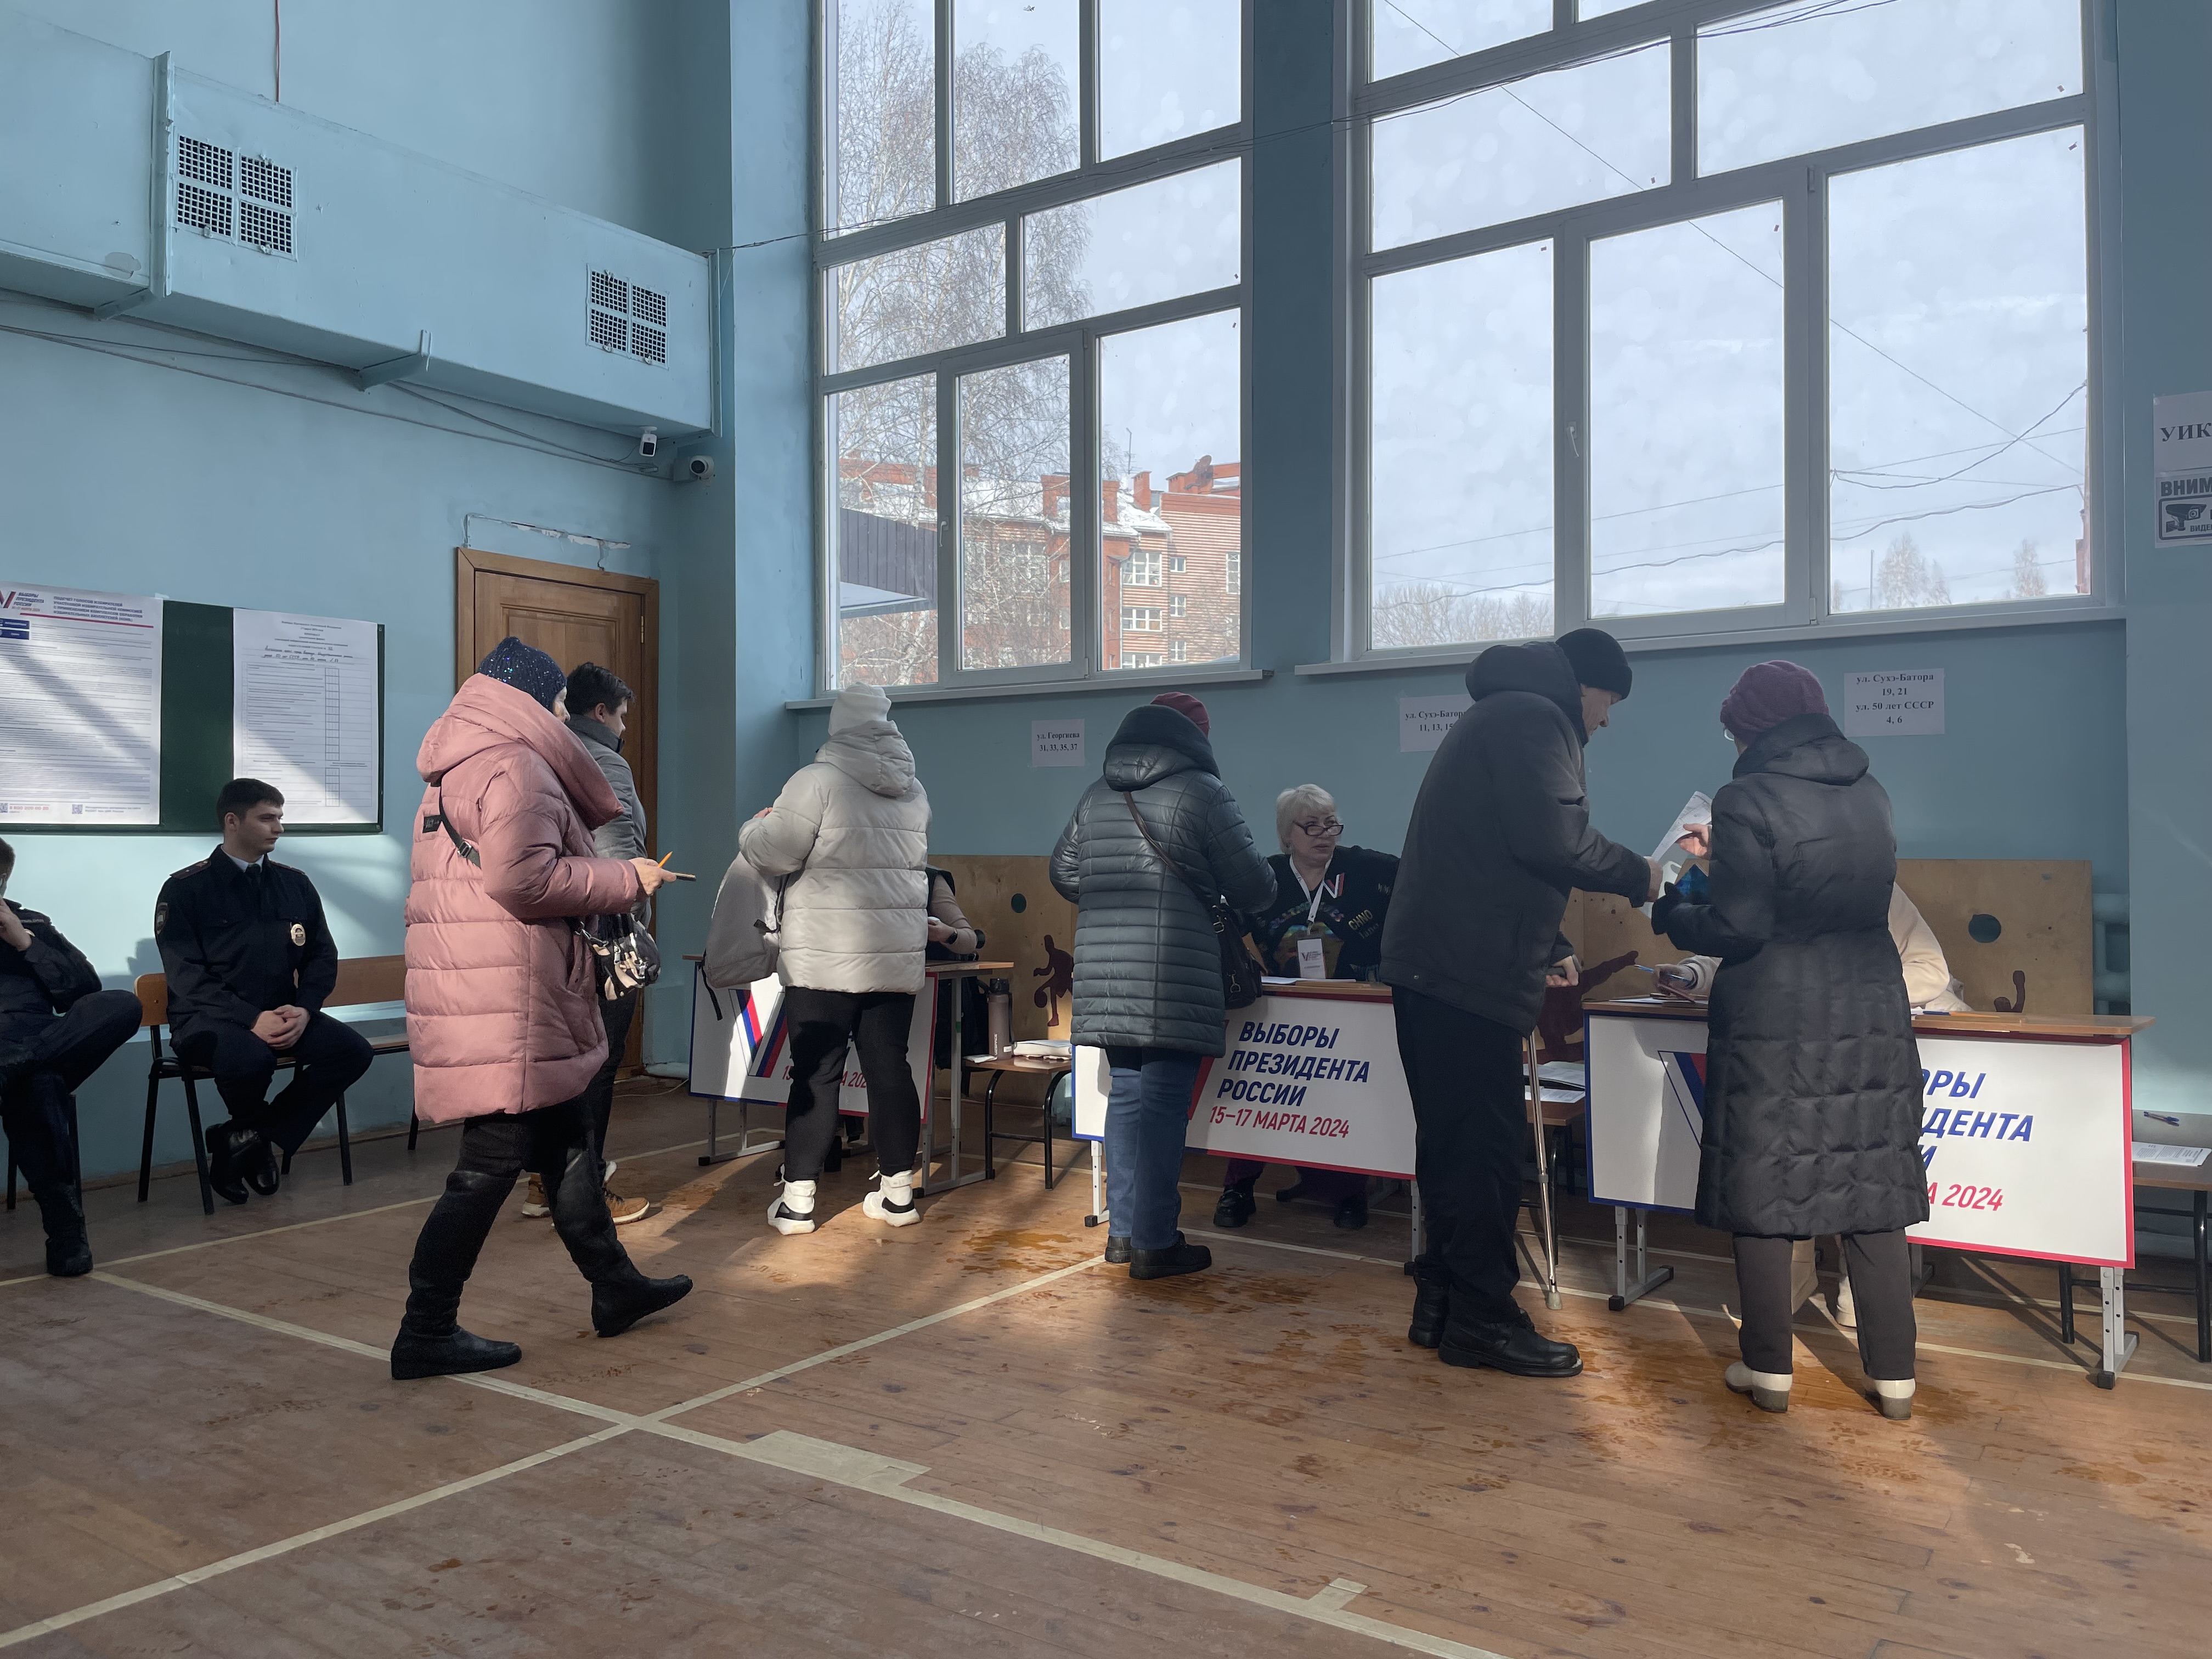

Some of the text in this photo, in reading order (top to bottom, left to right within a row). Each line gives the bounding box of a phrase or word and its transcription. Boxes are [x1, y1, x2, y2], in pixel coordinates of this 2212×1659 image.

[2159, 422, 2212, 442] УИК
[2161, 477, 2212, 496] ВНИМ
[2190, 524, 2212, 532] ВИДЕ
[1873, 674, 1934, 684] Сухэ-Батора
[1882, 688, 1895, 696] 19,
[1904, 701, 1934, 709] СССР
[1419, 710, 1464, 720] Сухэ-Батор
[1886, 716, 1894, 725] 4,
[1239, 1022, 1339, 1049] ВЫБОРЫ
[1228, 1049, 1370, 1083] ПРЕЗИДЕНТА
[1217, 1079, 1307, 1107] РОССИИ
[1253, 1110, 1306, 1134] МАРТА
[1309, 1117, 1350, 1138] 2024
[1921, 1107, 2034, 1142] ДЕНТА
[1942, 1183, 2004, 1211] 2024
